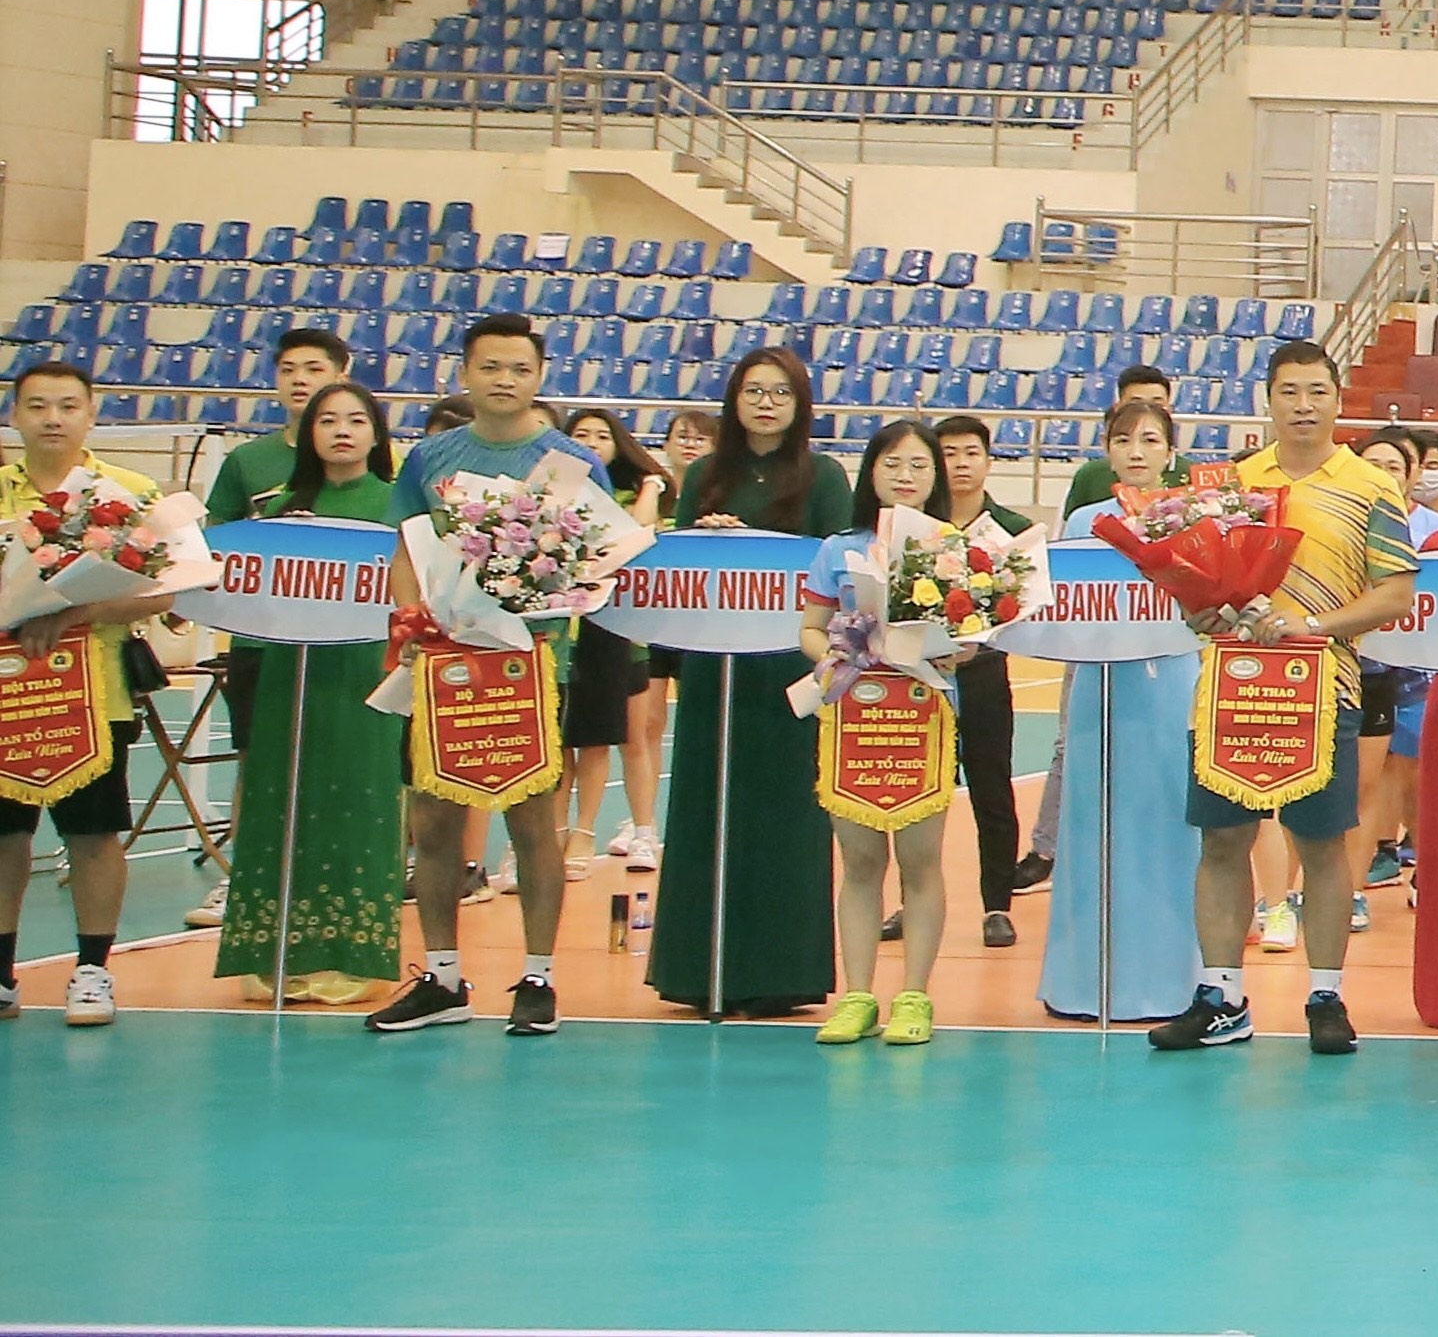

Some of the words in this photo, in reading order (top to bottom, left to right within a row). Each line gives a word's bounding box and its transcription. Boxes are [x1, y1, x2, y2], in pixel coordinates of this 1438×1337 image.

[272, 558, 346, 601] NINH
[719, 571, 786, 611] NINH
[1238, 684, 1260, 698] HỘI
[1262, 687, 1296, 698] THAO
[885, 709, 918, 719] THAO
[1222, 736, 1249, 746] BAN
[1252, 732, 1270, 746] TỔ
[1272, 736, 1306, 748] CHỨC
[847, 760, 874, 769] BAN
[876, 755, 893, 769] TỔ
